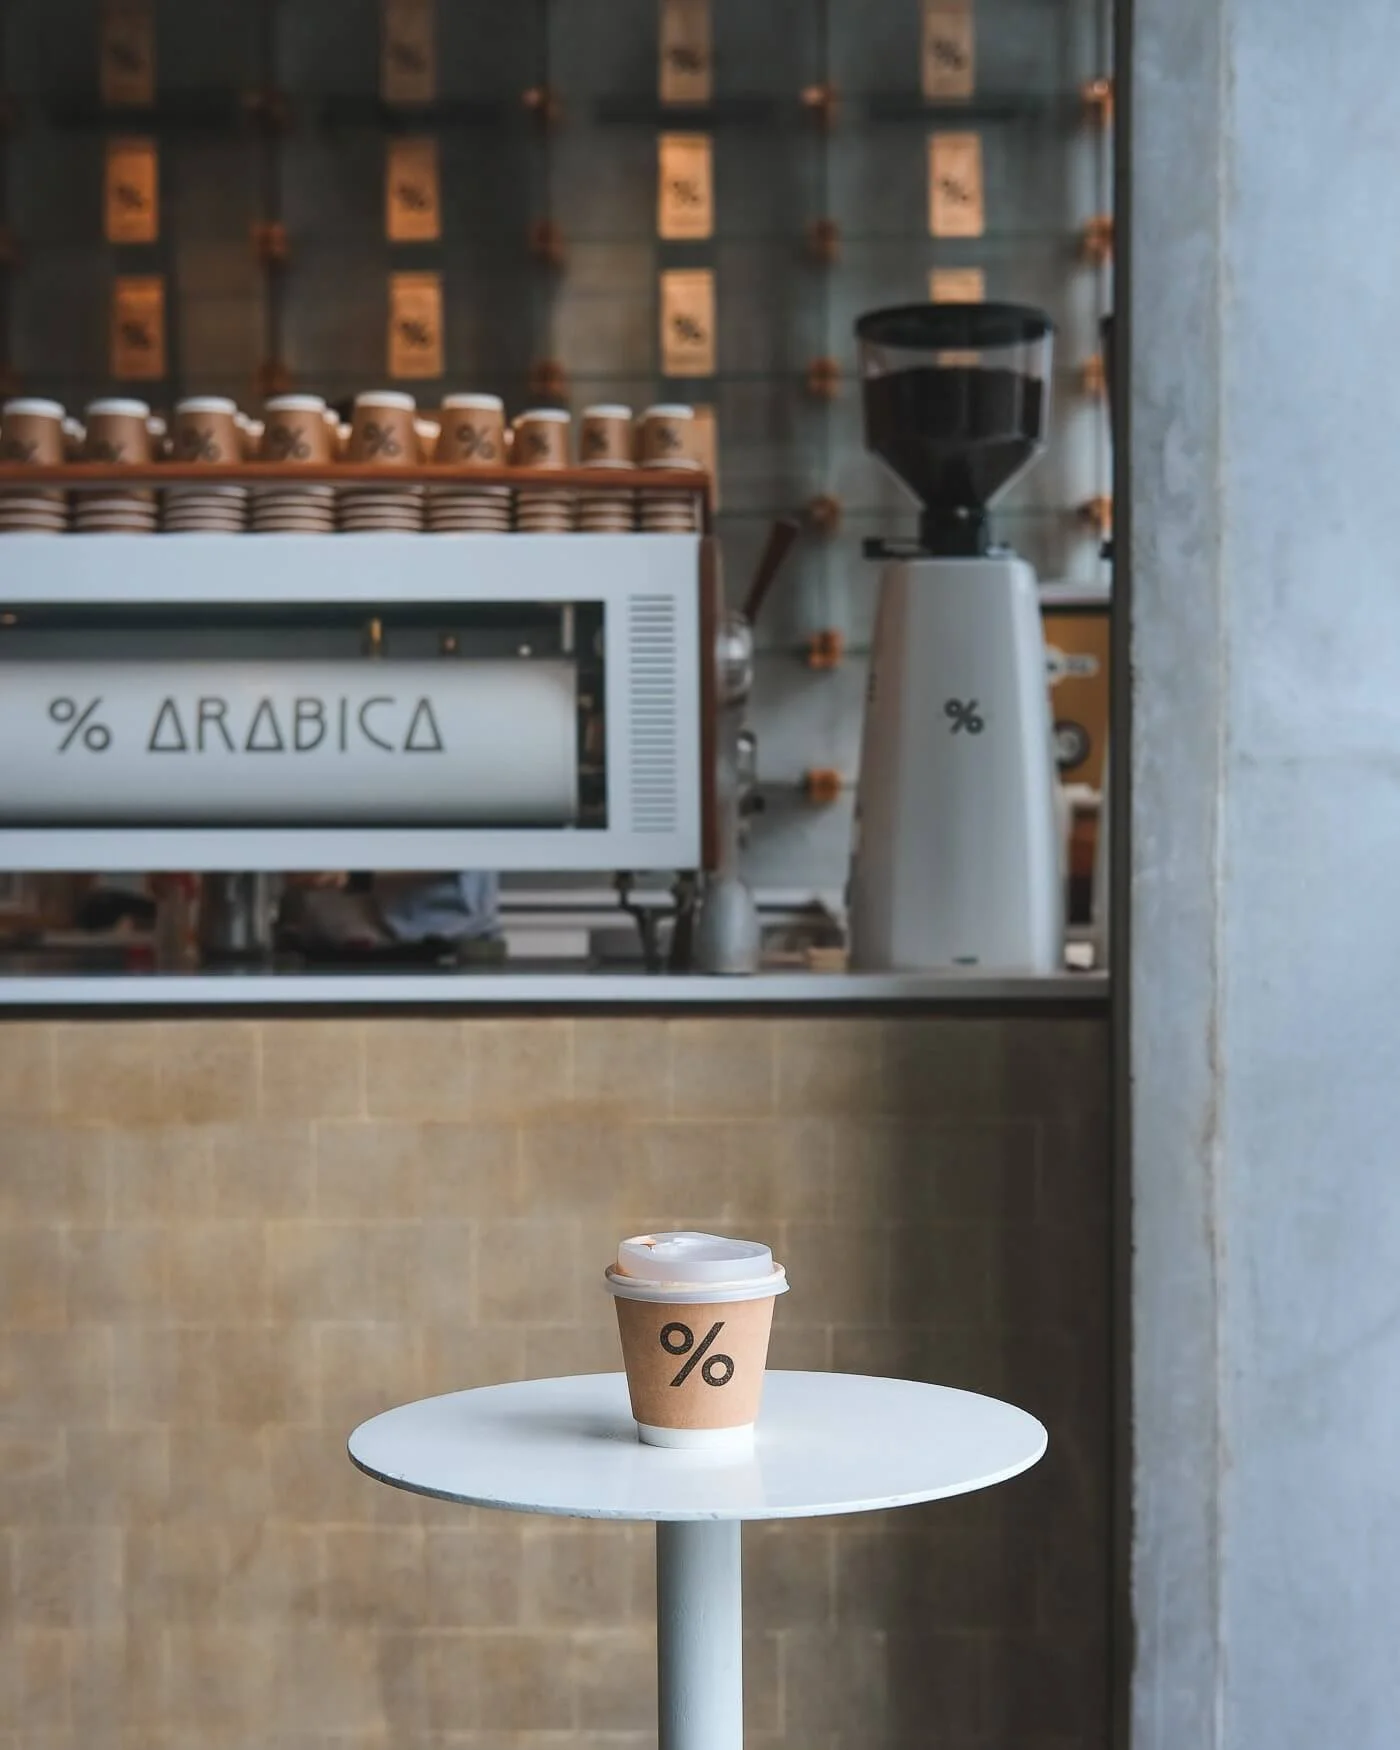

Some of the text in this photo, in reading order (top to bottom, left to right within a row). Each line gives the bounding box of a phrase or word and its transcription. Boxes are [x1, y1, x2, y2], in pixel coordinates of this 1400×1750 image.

[49, 696, 445, 753] % ARABICA
[944, 698, 985, 735] %
[659, 1321, 735, 1387] %
